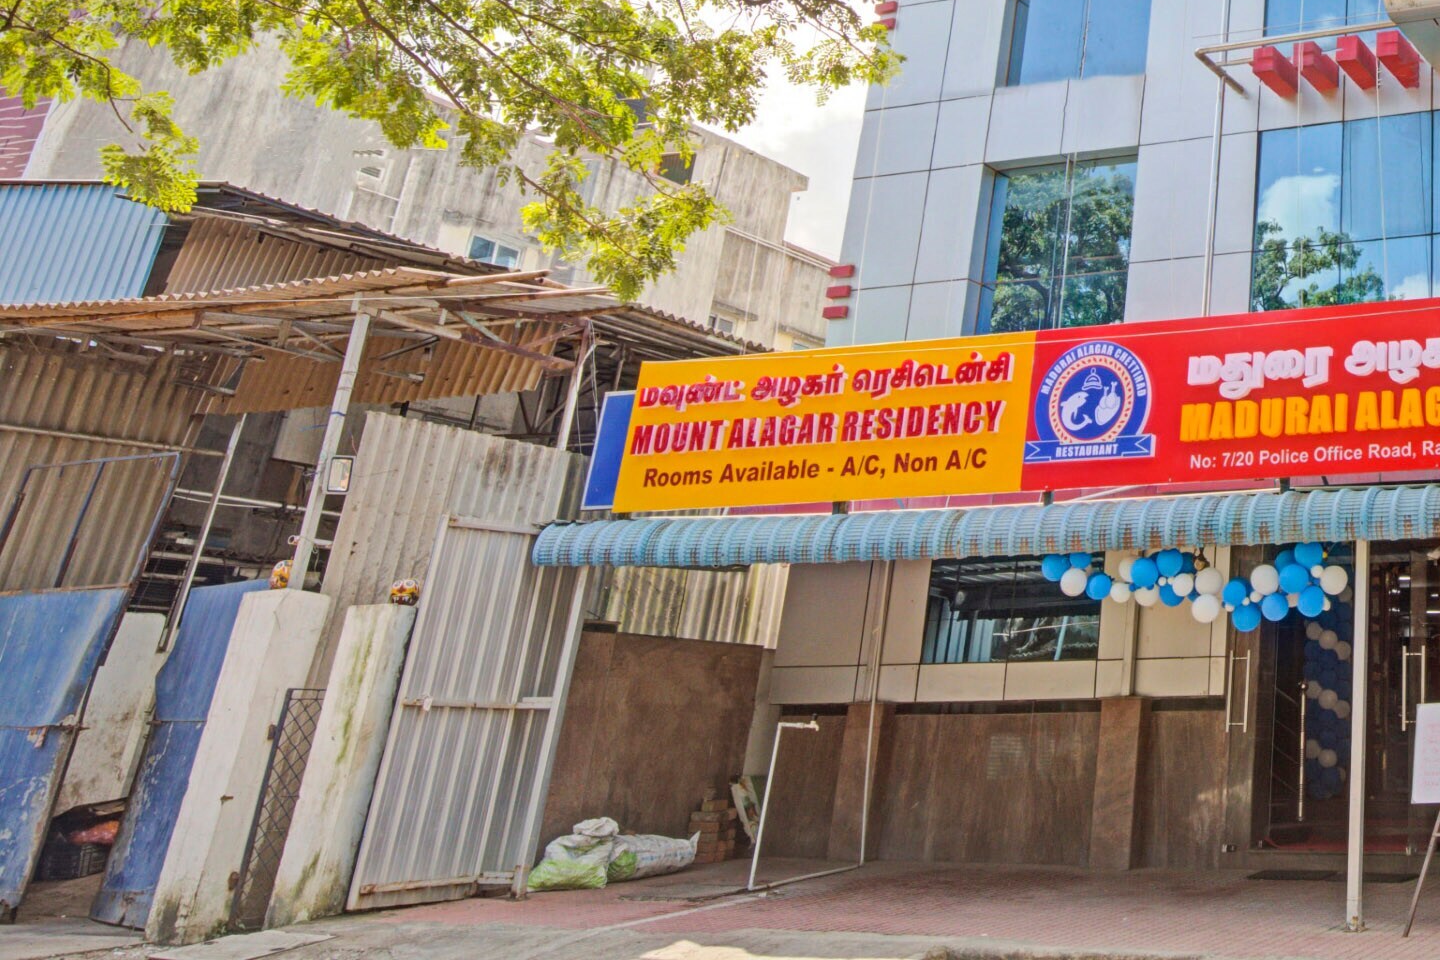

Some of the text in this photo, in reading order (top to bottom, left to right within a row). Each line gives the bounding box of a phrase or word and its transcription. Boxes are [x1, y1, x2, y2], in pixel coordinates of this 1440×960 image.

[639, 351, 1013, 412] மவுண்ட் அழகர் ரெசிடென்சி
[1041, 343, 1147, 397] MADURAI ALAGAR CHETTINAD
[1186, 344, 1333, 400] மதுரை
[630, 399, 1006, 456] MOUNT ALAGAR RESIDENCY
[1180, 393, 1348, 441] MADURAI
[643, 466, 713, 488] Rooms
[719, 457, 819, 484] Available
[841, 452, 886, 479] A/C,
[894, 451, 938, 474] Non
[946, 448, 988, 470] A/C
[1055, 443, 1118, 458] RESTAURANT
[1190, 454, 1217, 470] No:
[1221, 451, 1254, 467] 7/20
[1258, 447, 1309, 467] Police
[1313, 443, 1364, 462] Office
[1368, 440, 1417, 461] Road,
